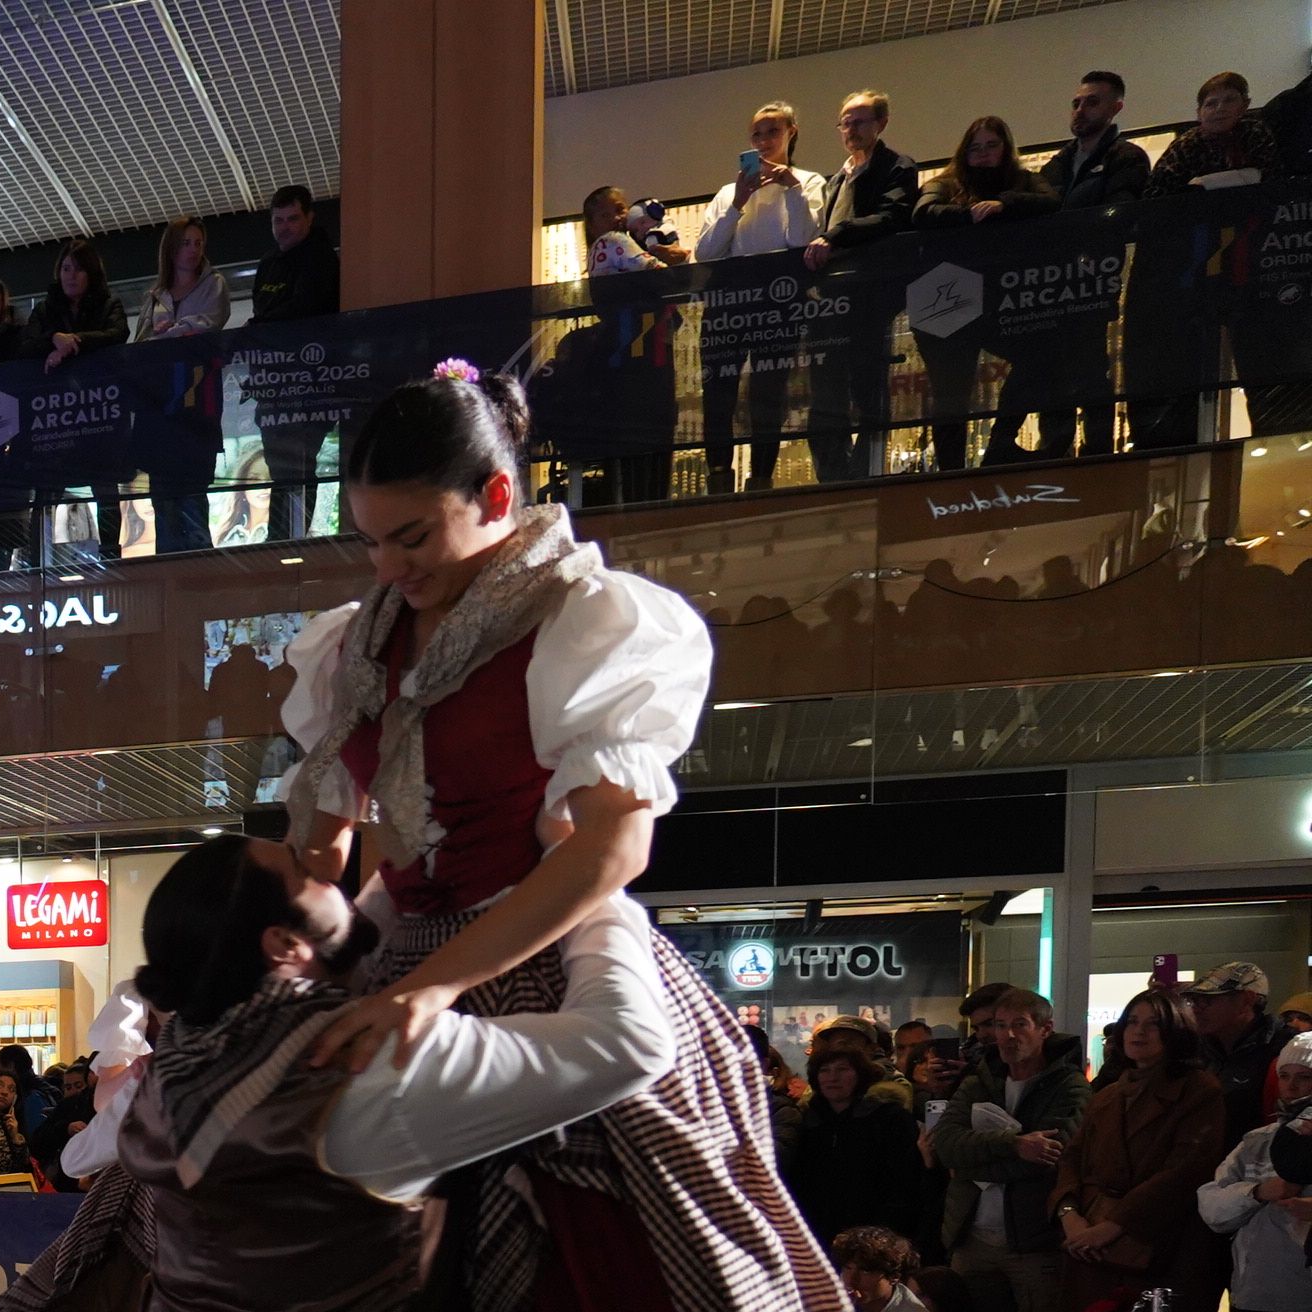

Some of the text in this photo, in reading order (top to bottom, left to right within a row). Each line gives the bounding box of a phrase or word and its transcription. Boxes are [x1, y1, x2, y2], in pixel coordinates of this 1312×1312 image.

[1000, 257, 1121, 289] ORDINO
[999, 275, 1121, 312] ARCALÍS
[788, 296, 851, 321] 2026
[741, 323, 809, 343] ARCALÍS
[231, 349, 296, 366] Allianz
[222, 363, 371, 387] Andorra 2026
[30, 384, 120, 411] ORDINO
[278, 384, 336, 398] ARCALÍS
[30, 401, 122, 431] ARCALÍS
[260, 407, 352, 428] MAMMUT
[21, 929, 93, 939] MILANO
[792, 944, 906, 979] TTOL
